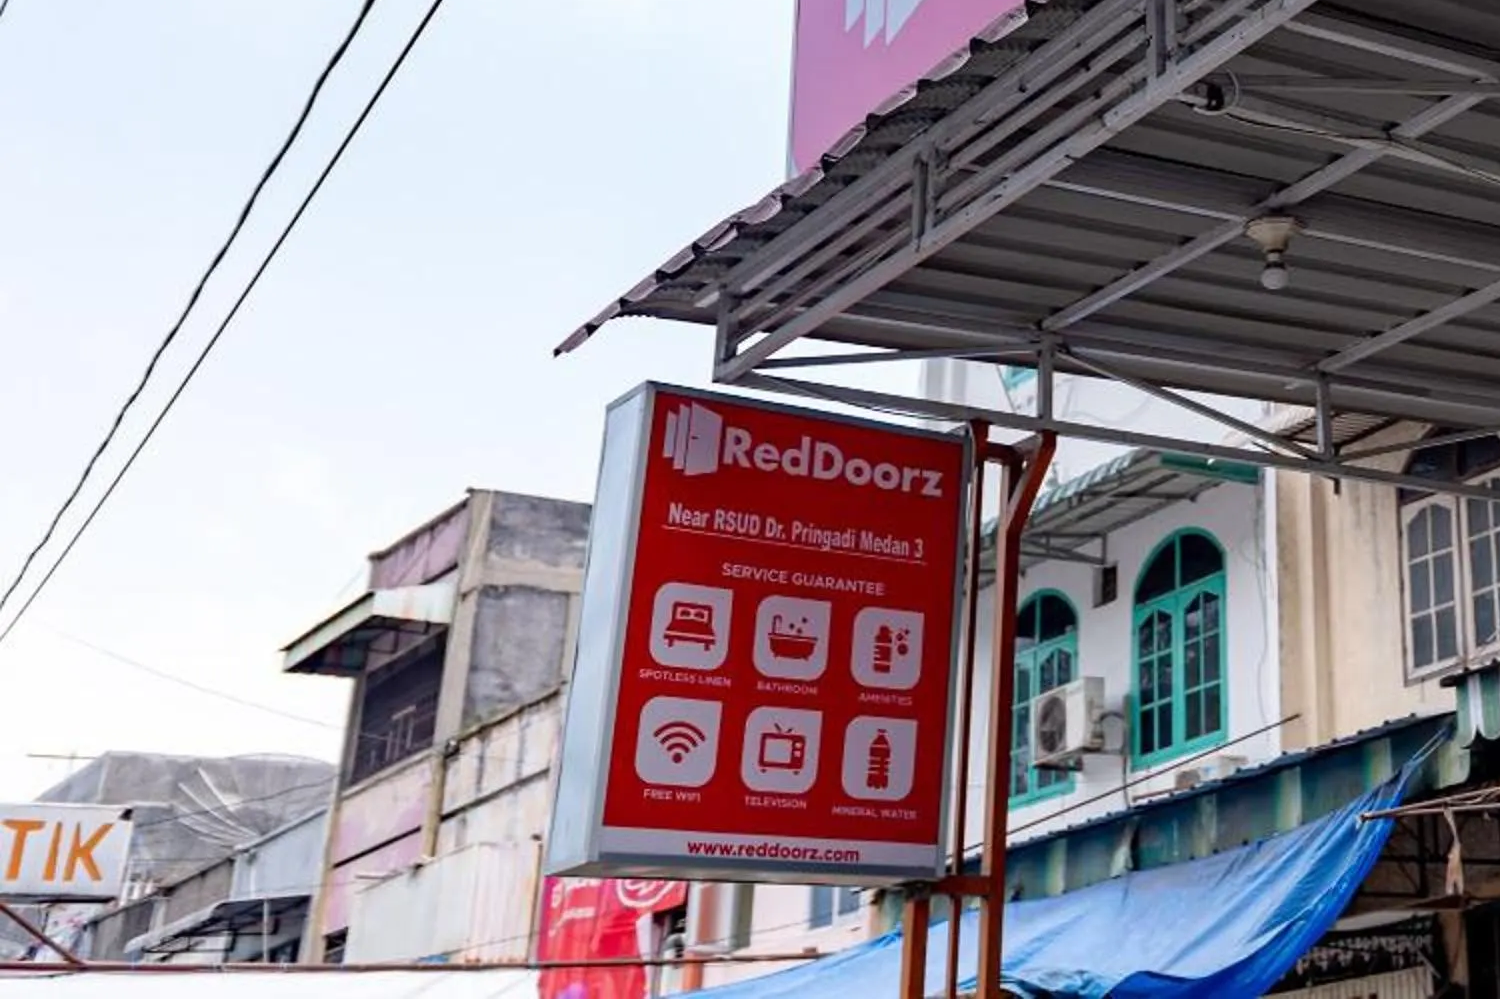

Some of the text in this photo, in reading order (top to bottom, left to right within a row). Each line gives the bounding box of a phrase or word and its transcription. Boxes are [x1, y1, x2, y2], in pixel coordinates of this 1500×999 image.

[722, 426, 943, 498] RedDoorz
[668, 502, 924, 558] Near RSUD Dr. Pringadi Medan 3
[721, 561, 886, 597] SERVICE GUARANTEE
[638, 668, 732, 688] SPOTLESS LINEN
[756, 680, 819, 696] BATHROOM
[643, 788, 701, 803] FREE WIFI
[744, 795, 807, 810] TELEVISION
[831, 805, 917, 821] MINERAL WATER
[2, 819, 116, 881] TIK
[687, 840, 860, 863] www.reddoorz.com
